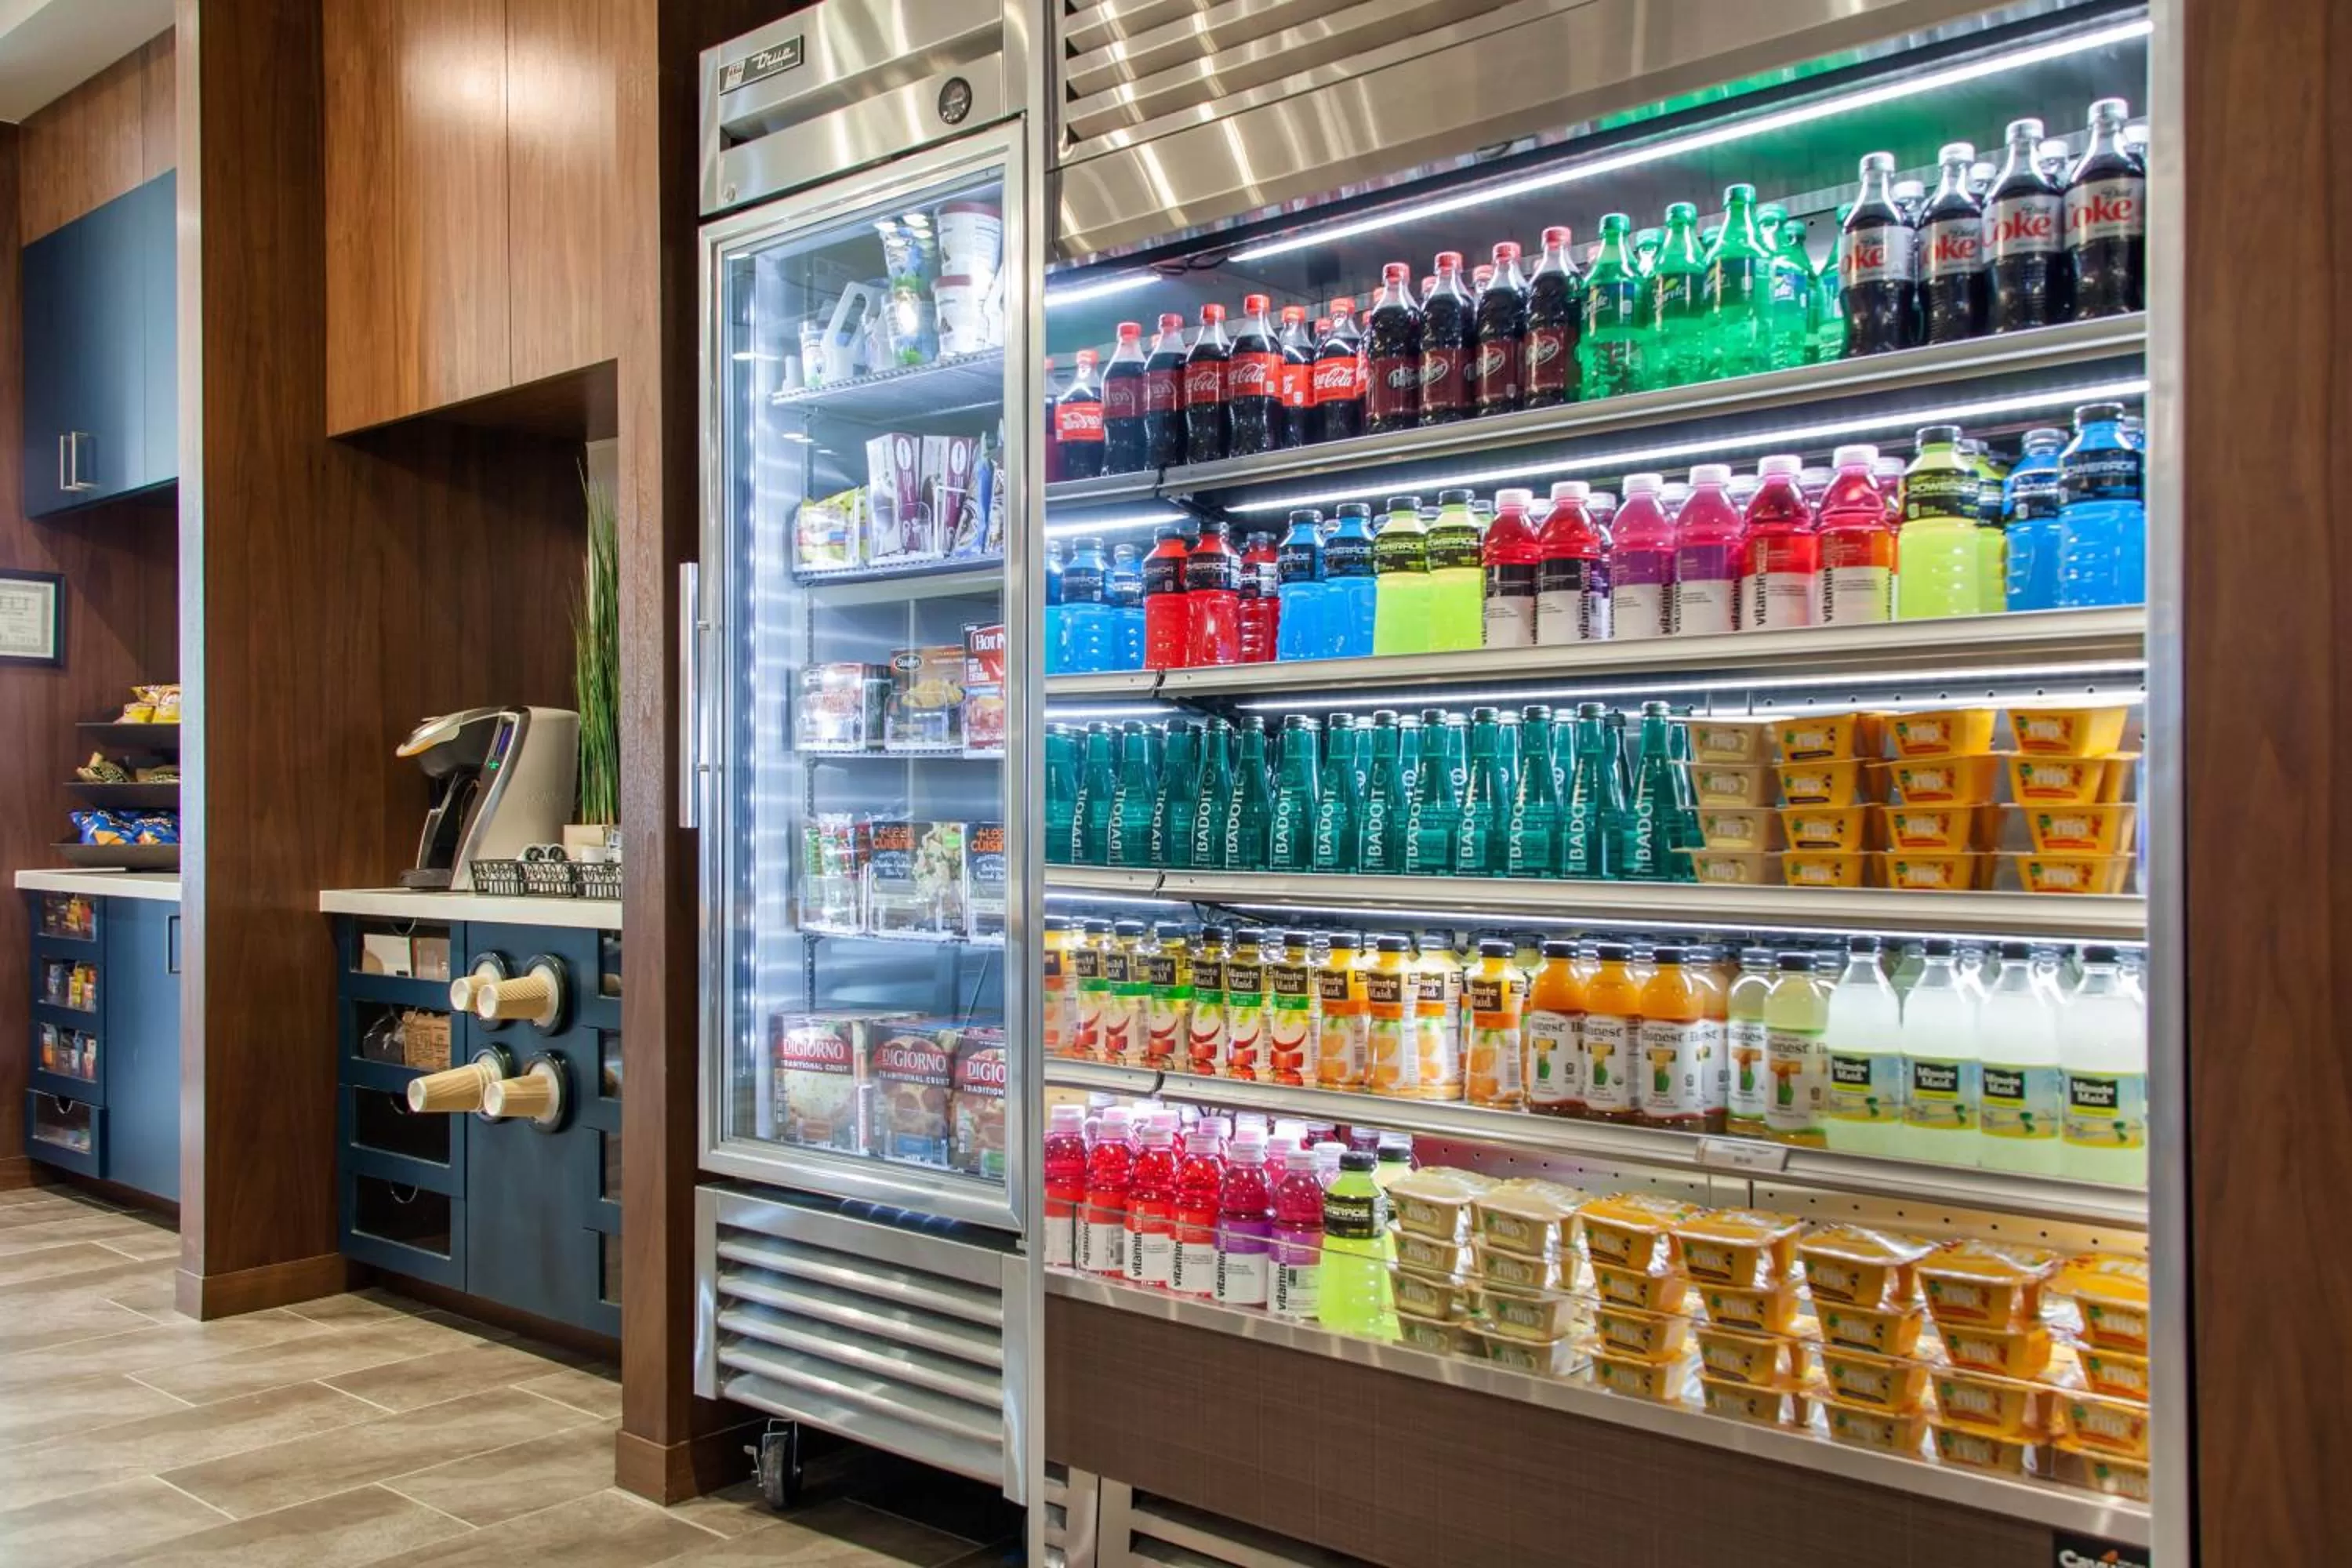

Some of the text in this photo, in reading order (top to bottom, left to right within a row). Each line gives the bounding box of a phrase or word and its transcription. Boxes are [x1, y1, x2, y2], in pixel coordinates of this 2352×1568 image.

[1841, 247, 1886, 275] oke
[1922, 234, 1977, 265] oke
[1196, 787, 1214, 853] BADOIT
[1228, 787, 1245, 854] BADOIT
[1275, 787, 1292, 855] BADOIT
[1319, 787, 1337, 855] BADOIT
[1368, 787, 1385, 856] BADOIT
[1406, 787, 1425, 857] BADOIT
[1570, 787, 1588, 861] BADOIT
[1635, 787, 1654, 864] BADOIT
[963, 1085, 1004, 1097] TRADITION
[967, 1060, 1004, 1083] DIGIO
